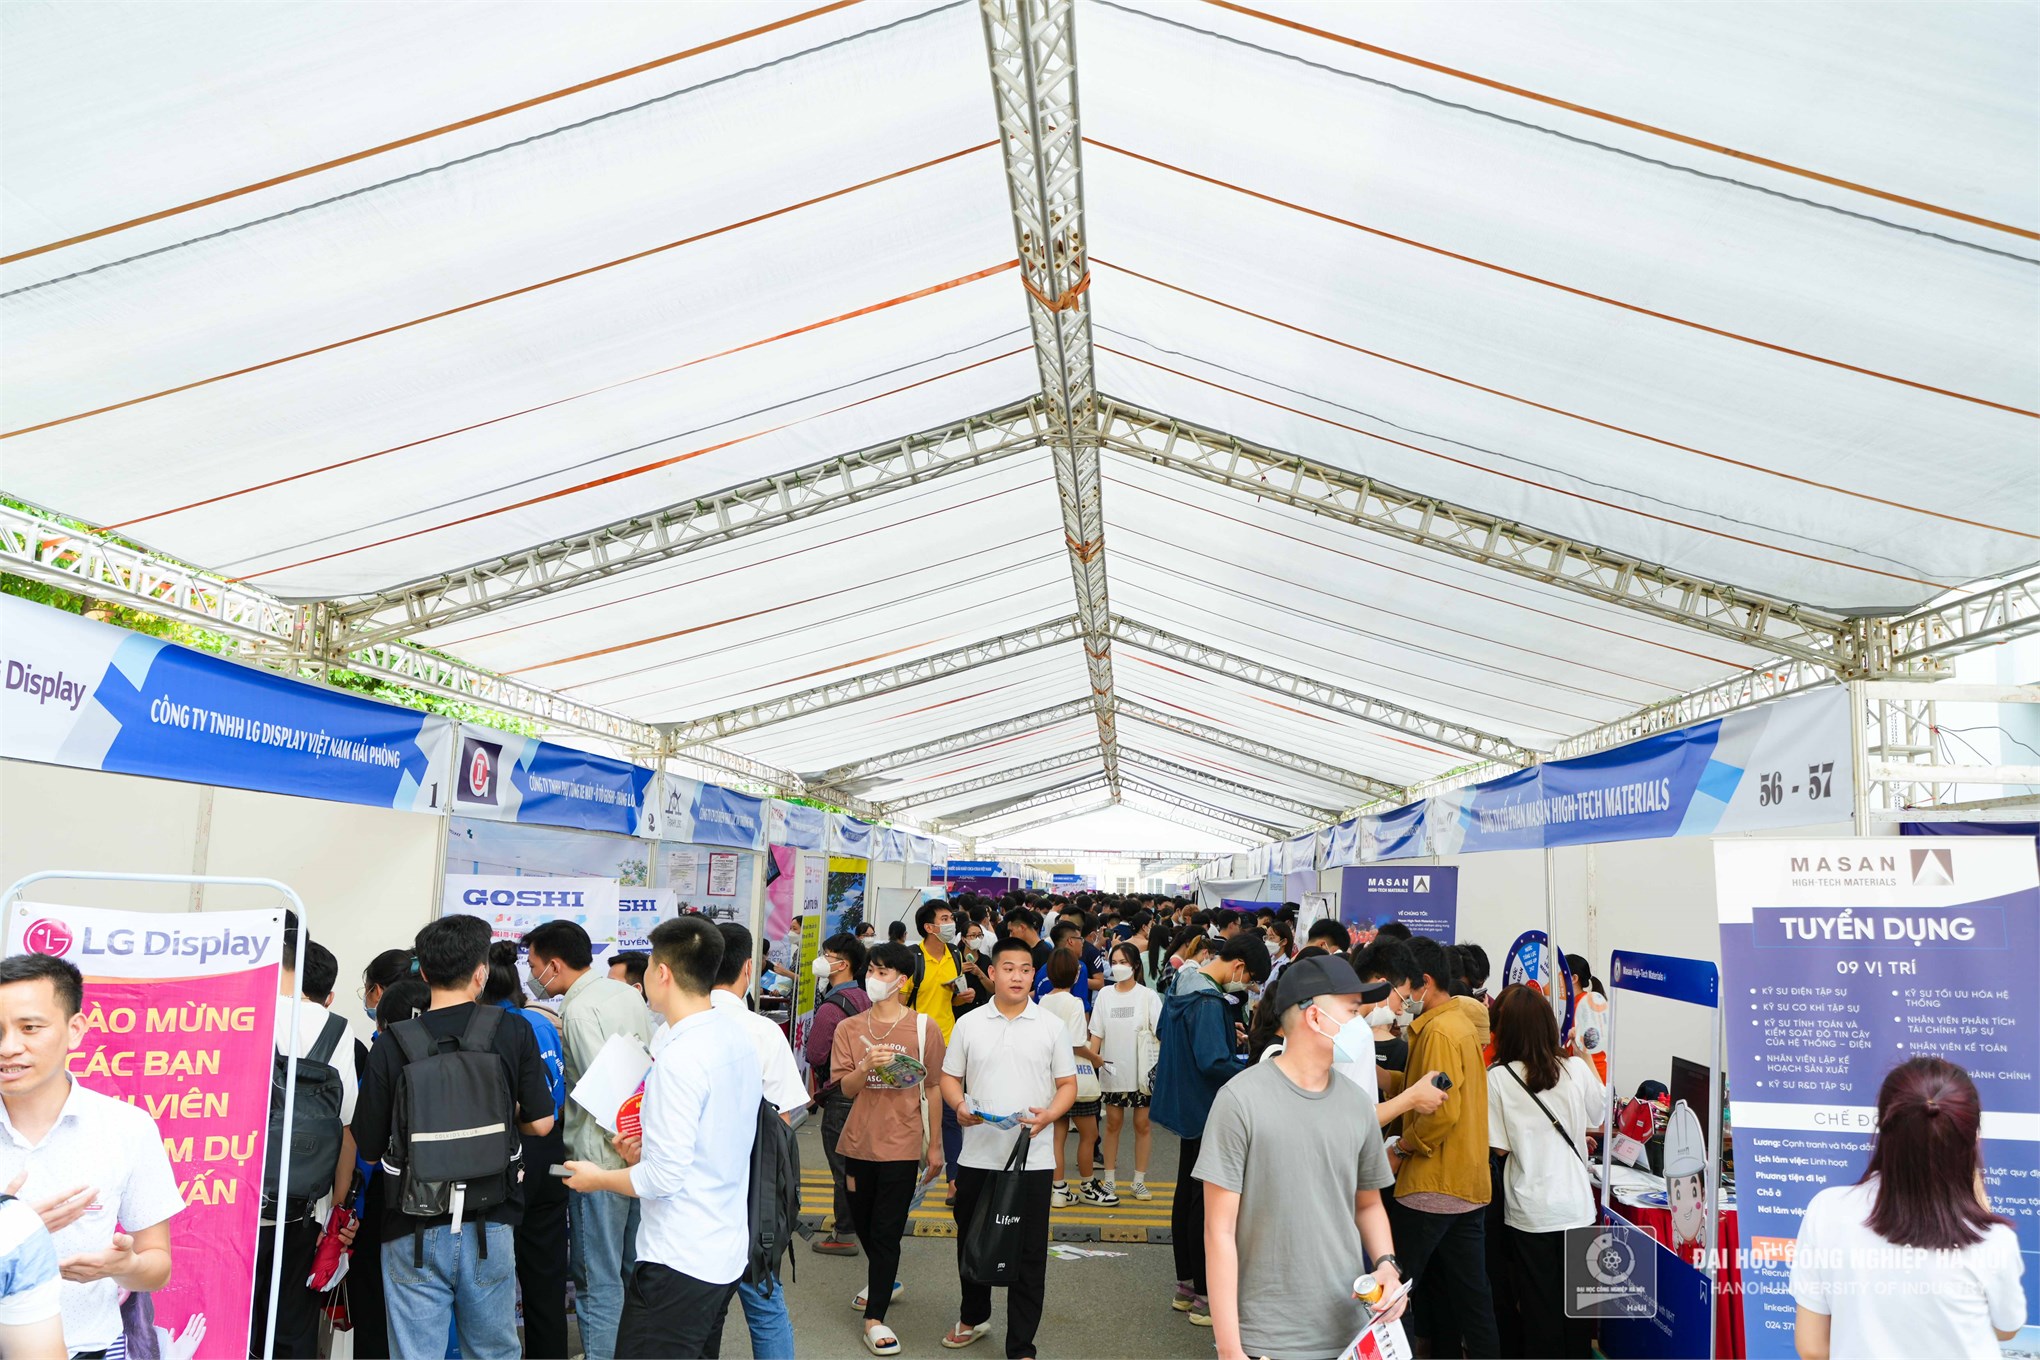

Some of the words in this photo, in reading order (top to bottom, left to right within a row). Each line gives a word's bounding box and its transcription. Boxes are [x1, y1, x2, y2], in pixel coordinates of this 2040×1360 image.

[6, 660, 87, 711] Display
[150, 694, 190, 728] CÔNG
[192, 707, 208, 732] TY
[210, 711, 245, 739] TNHH
[245, 720, 260, 742] LG
[261, 723, 308, 751] DISPLAY
[307, 729, 330, 760] VIỆT
[328, 738, 352, 760] NAM
[352, 738, 368, 764] HẢI
[369, 742, 400, 770] PHÒNG
[1758, 771, 1783, 808] 56
[1808, 760, 1835, 801] 57
[429, 782, 438, 809] 1
[1526, 798, 1550, 828] MASAN
[1551, 789, 1602, 824] HIGH-TECH
[1604, 777, 1670, 818] MATERIALS
[648, 813, 656, 832] 2
[1790, 856, 1896, 872] MASAN
[1368, 878, 1409, 886] MASAN
[1792, 878, 1842, 886] HIGH-TECH
[1844, 878, 1896, 887] MATERIALS
[462, 889, 584, 908] GOSHI
[1780, 908, 1875, 940] TUYỂN
[1883, 917, 1976, 946] DỤNG
[82, 926, 135, 957] LG
[143, 927, 270, 964] Display
[1836, 961, 1859, 975] 09
[1864, 961, 1883, 977] VỊ
[1888, 958, 1917, 975] TRÍ
[1791, 987, 1812, 996] ĐIỆN
[1815, 987, 1832, 996] TẬP
[1935, 989, 1951, 998] TỐI
[1972, 989, 1993, 999] HÓA
[1996, 990, 2009, 1000] HỆ
[1827, 1004, 1844, 1013] TẬP
[1905, 998, 1941, 1008] THỐNG
[145, 1001, 256, 1032] MỪNG
[1907, 1015, 1934, 1024] NHÂN
[1937, 1015, 1958, 1024] VIÊN
[1962, 1016, 1989, 1025] PHÂN
[1992, 1016, 2016, 1025] TÍCH
[1793, 1018, 1814, 1027] TÍNH
[1817, 1020, 1843, 1028] TOÁN
[1789, 1029, 1812, 1037] SOÁT
[1816, 1029, 1830, 1039] ĐỘ
[1834, 1030, 1849, 1038] TIN
[1925, 1025, 1956, 1034] CHÍNH
[1960, 1026, 1977, 1036] TẬP
[1788, 1038, 1800, 1047] HỆ
[1803, 1038, 1836, 1048] THỐNG
[1849, 1039, 1871, 1049] ĐIỆN
[1910, 1042, 1936, 1050] NHÂN
[1940, 1042, 1961, 1051] VIÊN
[1965, 1042, 1976, 1052] KẾ
[1979, 1043, 2007, 1052] TOÁN
[64, 1044, 136, 1078] CÁC
[144, 1049, 220, 1083] BẠN
[1767, 1054, 1792, 1062] NHÂN
[1795, 1054, 1816, 1063] VIÊN
[1819, 1055, 1836, 1065] LẬP
[1838, 1055, 1849, 1064] KẾ
[1767, 1064, 1801, 1073] HOẠCH
[1826, 1065, 1848, 1074] XUẤT
[1998, 1071, 2031, 1080] CHÍNH
[1820, 1081, 1836, 1091] TẬP
[149, 1088, 230, 1120] VIÊN
[1814, 1109, 1850, 1126] CHẾ
[203, 1129, 260, 1168] DỰ
[1782, 1139, 1804, 1148] Cạnh
[1806, 1141, 1827, 1149] tranh
[1755, 1155, 1771, 1164] Lịch
[1772, 1156, 1788, 1164] làm
[1810, 1158, 1826, 1166] Linh
[1828, 1158, 1848, 1167] hoạt
[1756, 1172, 1787, 1182] Phương
[1788, 1174, 1805, 1182] tiện
[1806, 1174, 1814, 1182] đi
[1990, 1167, 2007, 1176] luật
[2010, 1169, 2027, 1177] quy
[1773, 1206, 1789, 1214] làm
[1765, 1321, 1781, 1330] 024
